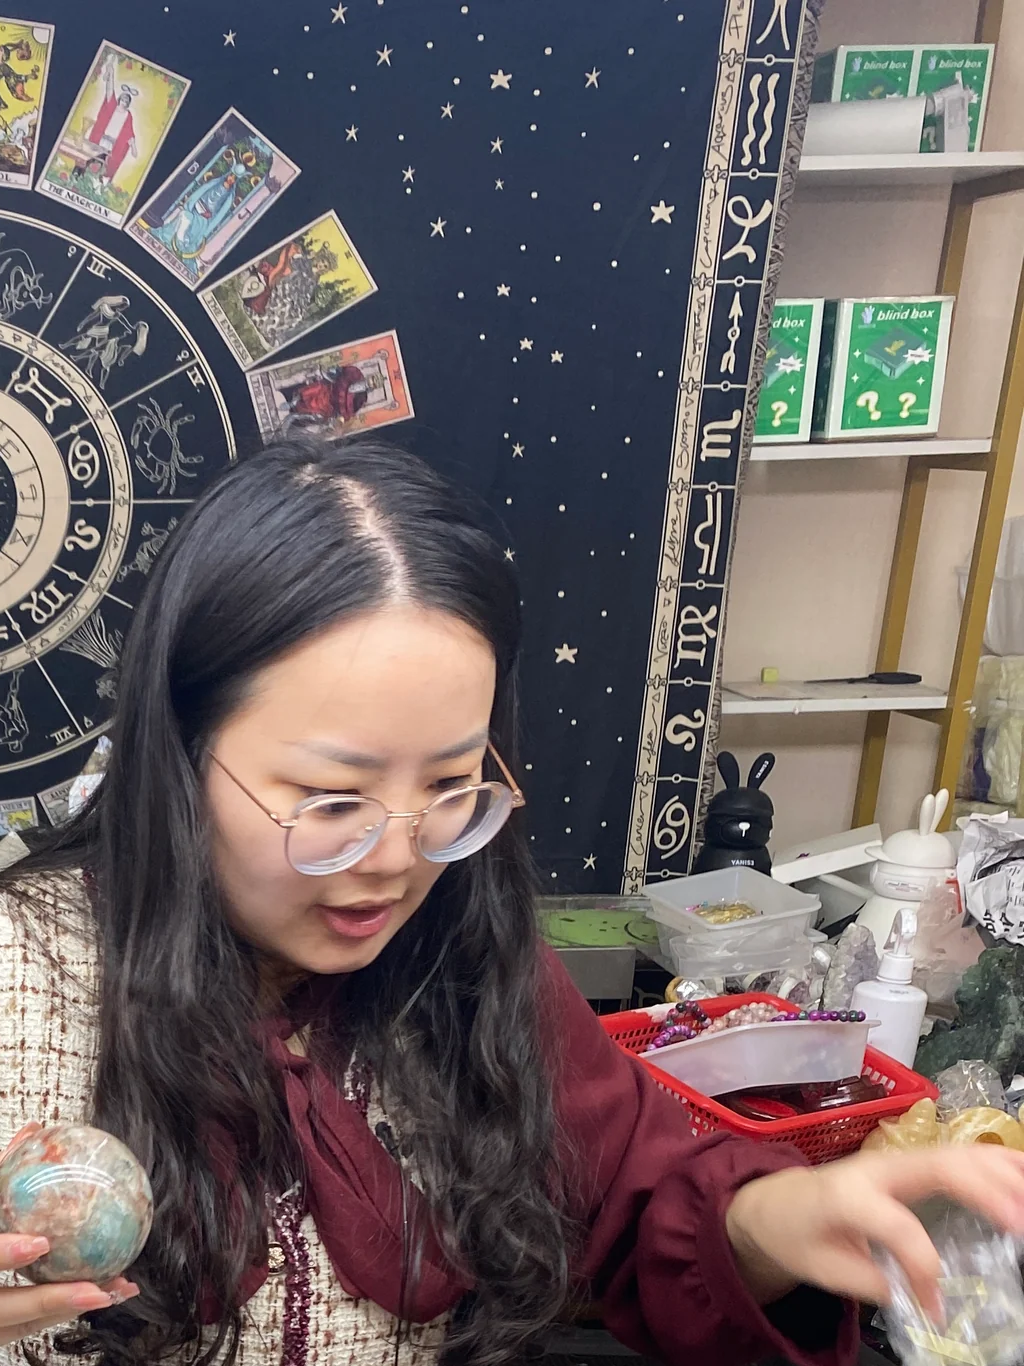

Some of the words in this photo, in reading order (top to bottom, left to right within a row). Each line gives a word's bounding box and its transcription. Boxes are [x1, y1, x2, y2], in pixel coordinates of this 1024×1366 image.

[863, 60, 888, 70] blind
[888, 61, 908, 69] box
[938, 59, 963, 68] blind
[963, 60, 984, 68] box
[48, 183, 64, 197] THE
[66, 190, 111, 217] MAGICIAN
[205, 296, 223, 318] THE
[877, 309, 909, 320] blind
[910, 308, 935, 319] box
[782, 318, 805, 327] box
